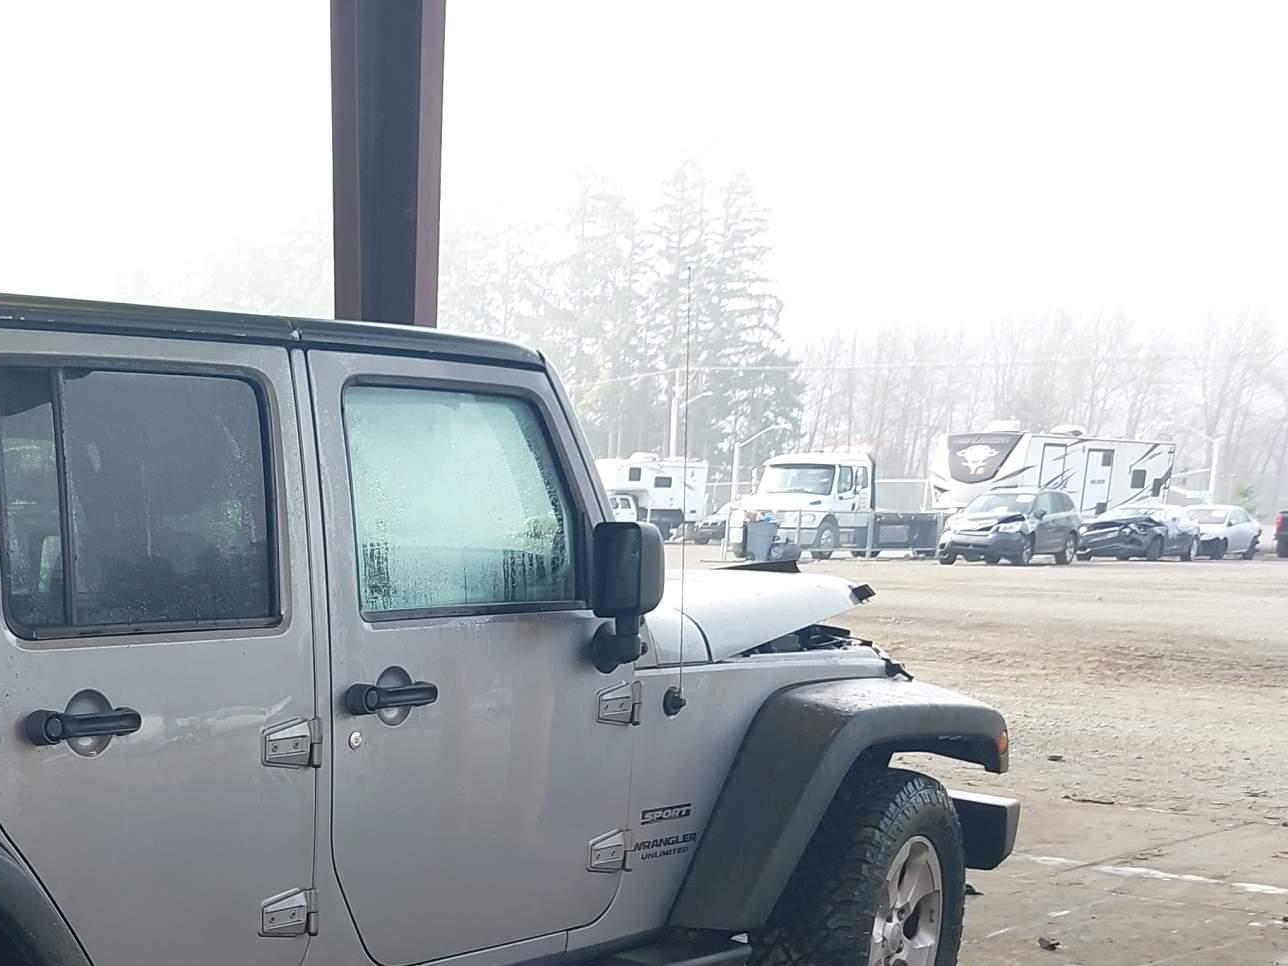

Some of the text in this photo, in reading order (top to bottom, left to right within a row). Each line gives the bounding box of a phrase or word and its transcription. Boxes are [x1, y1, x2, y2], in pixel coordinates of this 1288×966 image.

[642, 806, 691, 823] SPORT
[634, 832, 697, 851] WRANGLER
[641, 847, 689, 860] UNLIMITED
